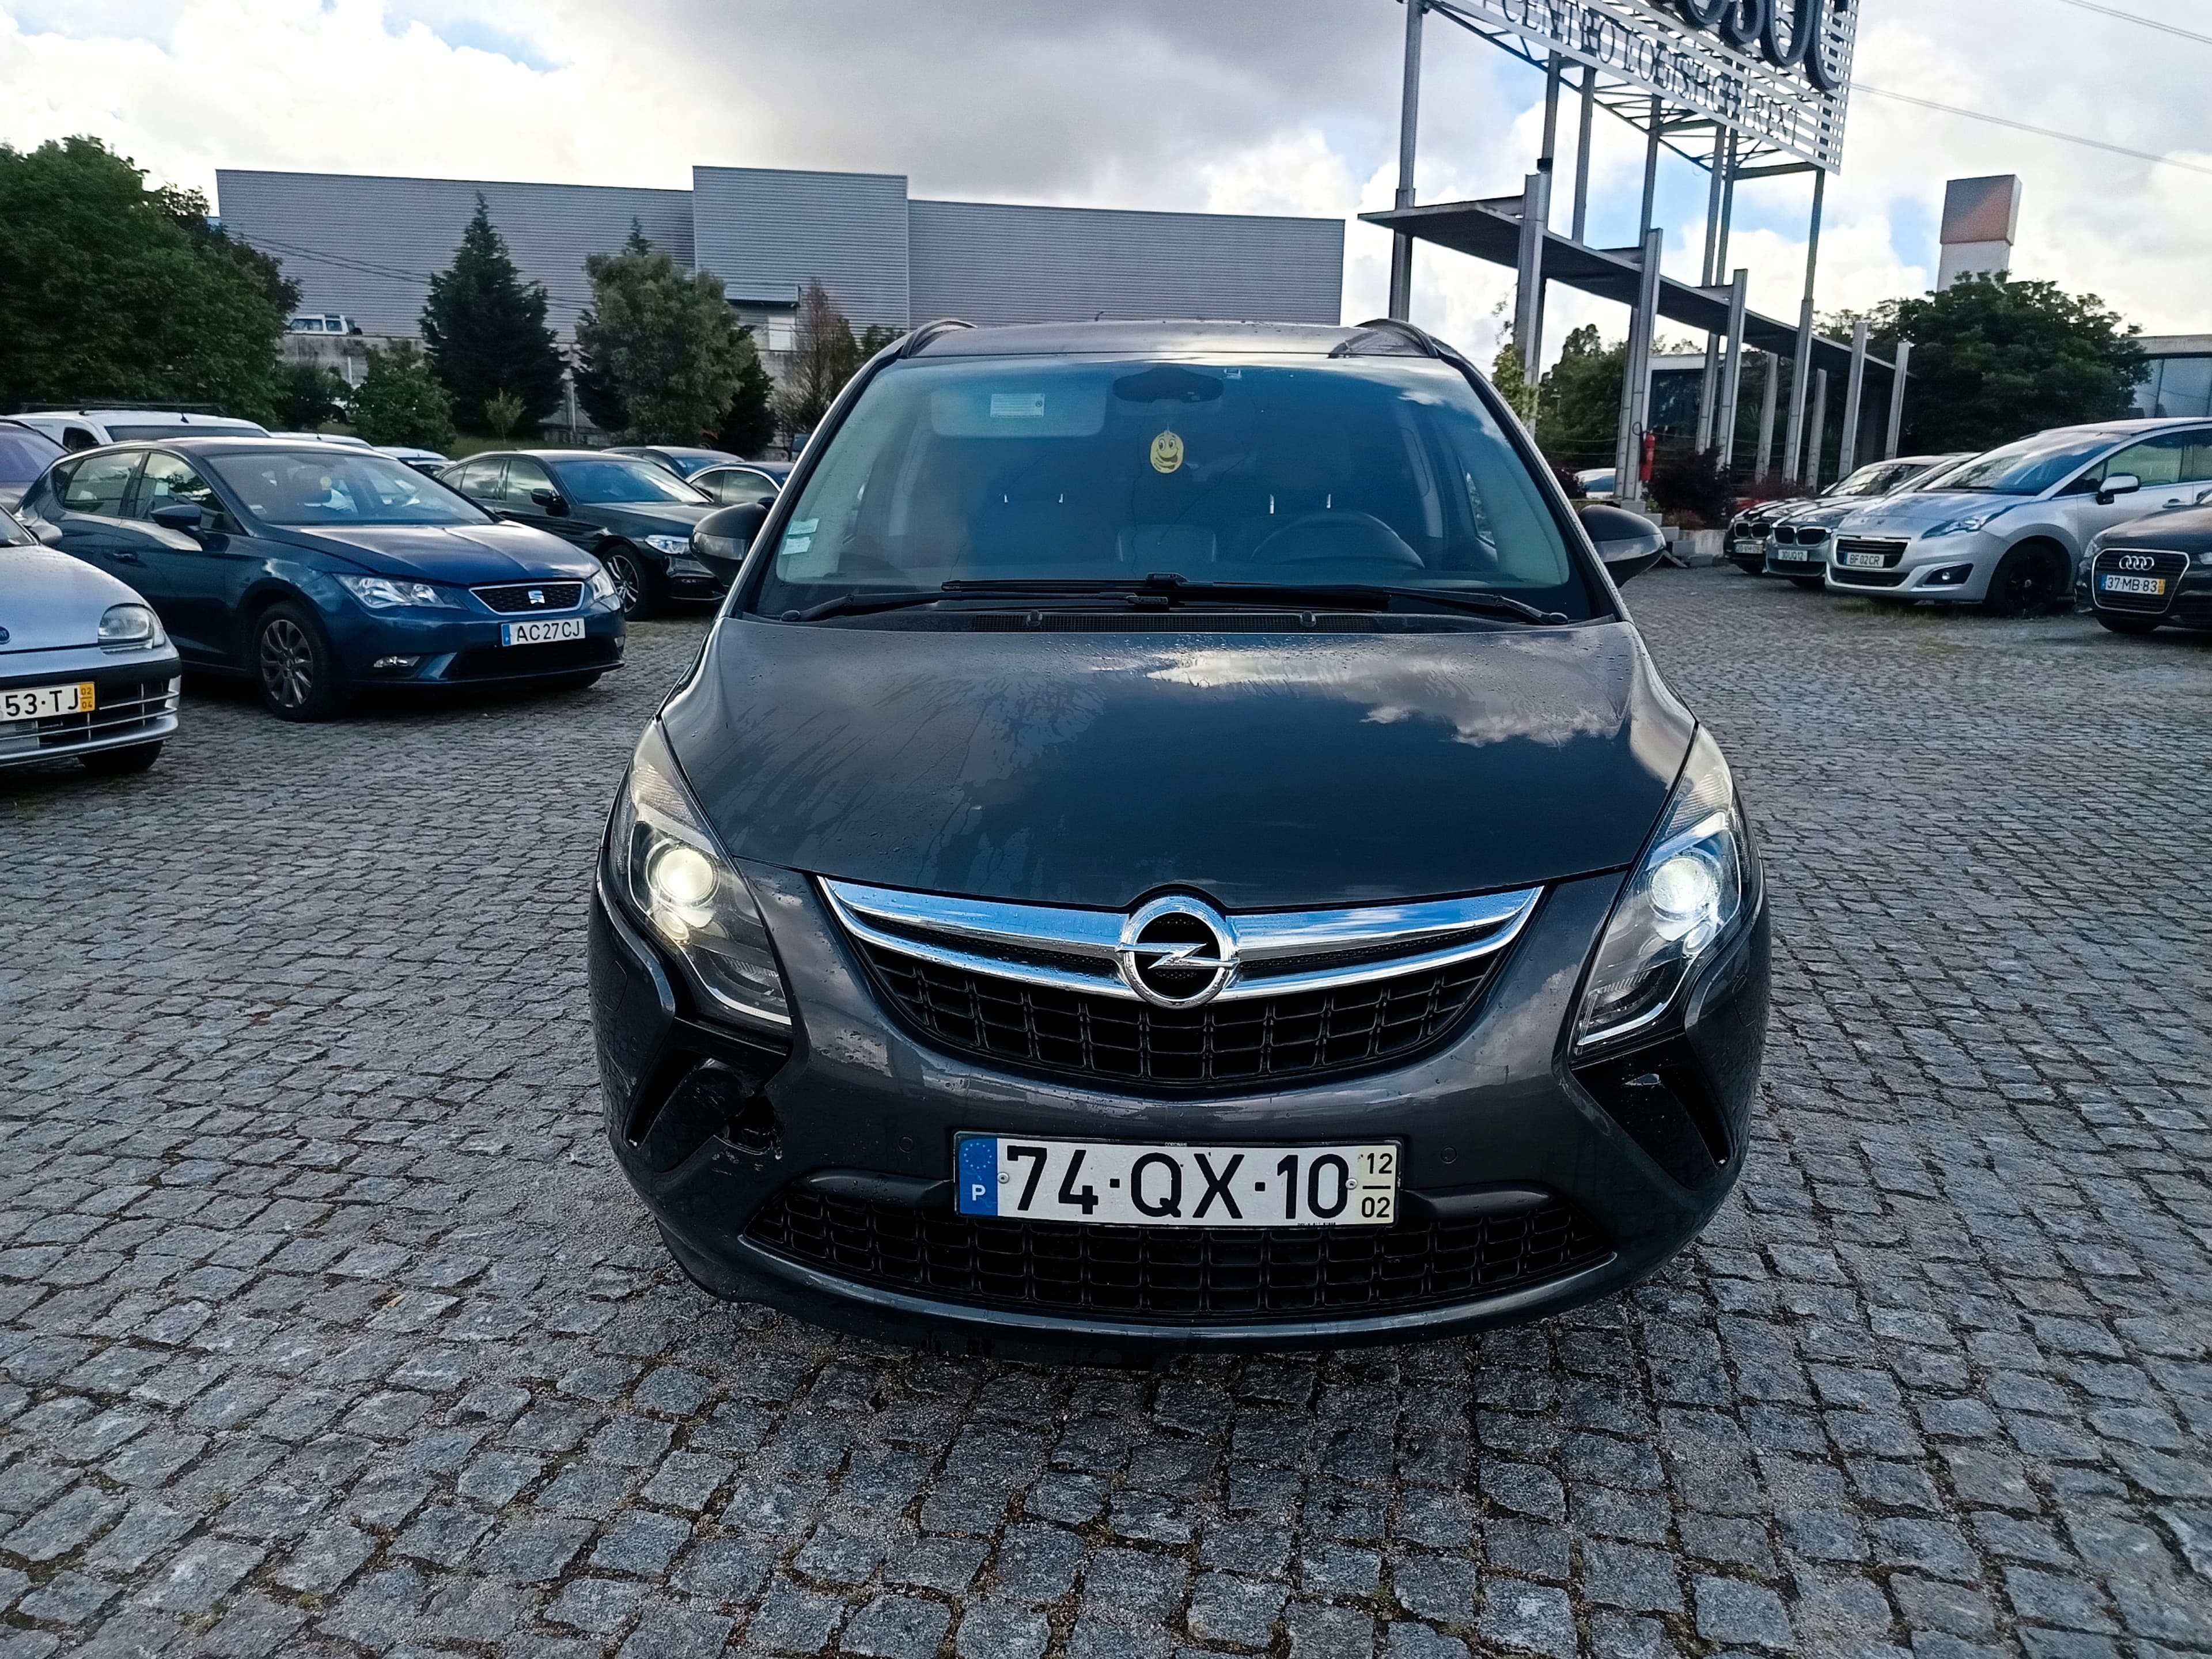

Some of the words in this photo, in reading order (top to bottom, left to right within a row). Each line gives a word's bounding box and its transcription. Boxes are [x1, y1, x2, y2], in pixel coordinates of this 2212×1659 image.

[81, 687, 92, 695] 02
[1367, 1153, 1393, 1174] 12
[972, 1184, 986, 1201] P
[1361, 1196, 1390, 1218] 02
